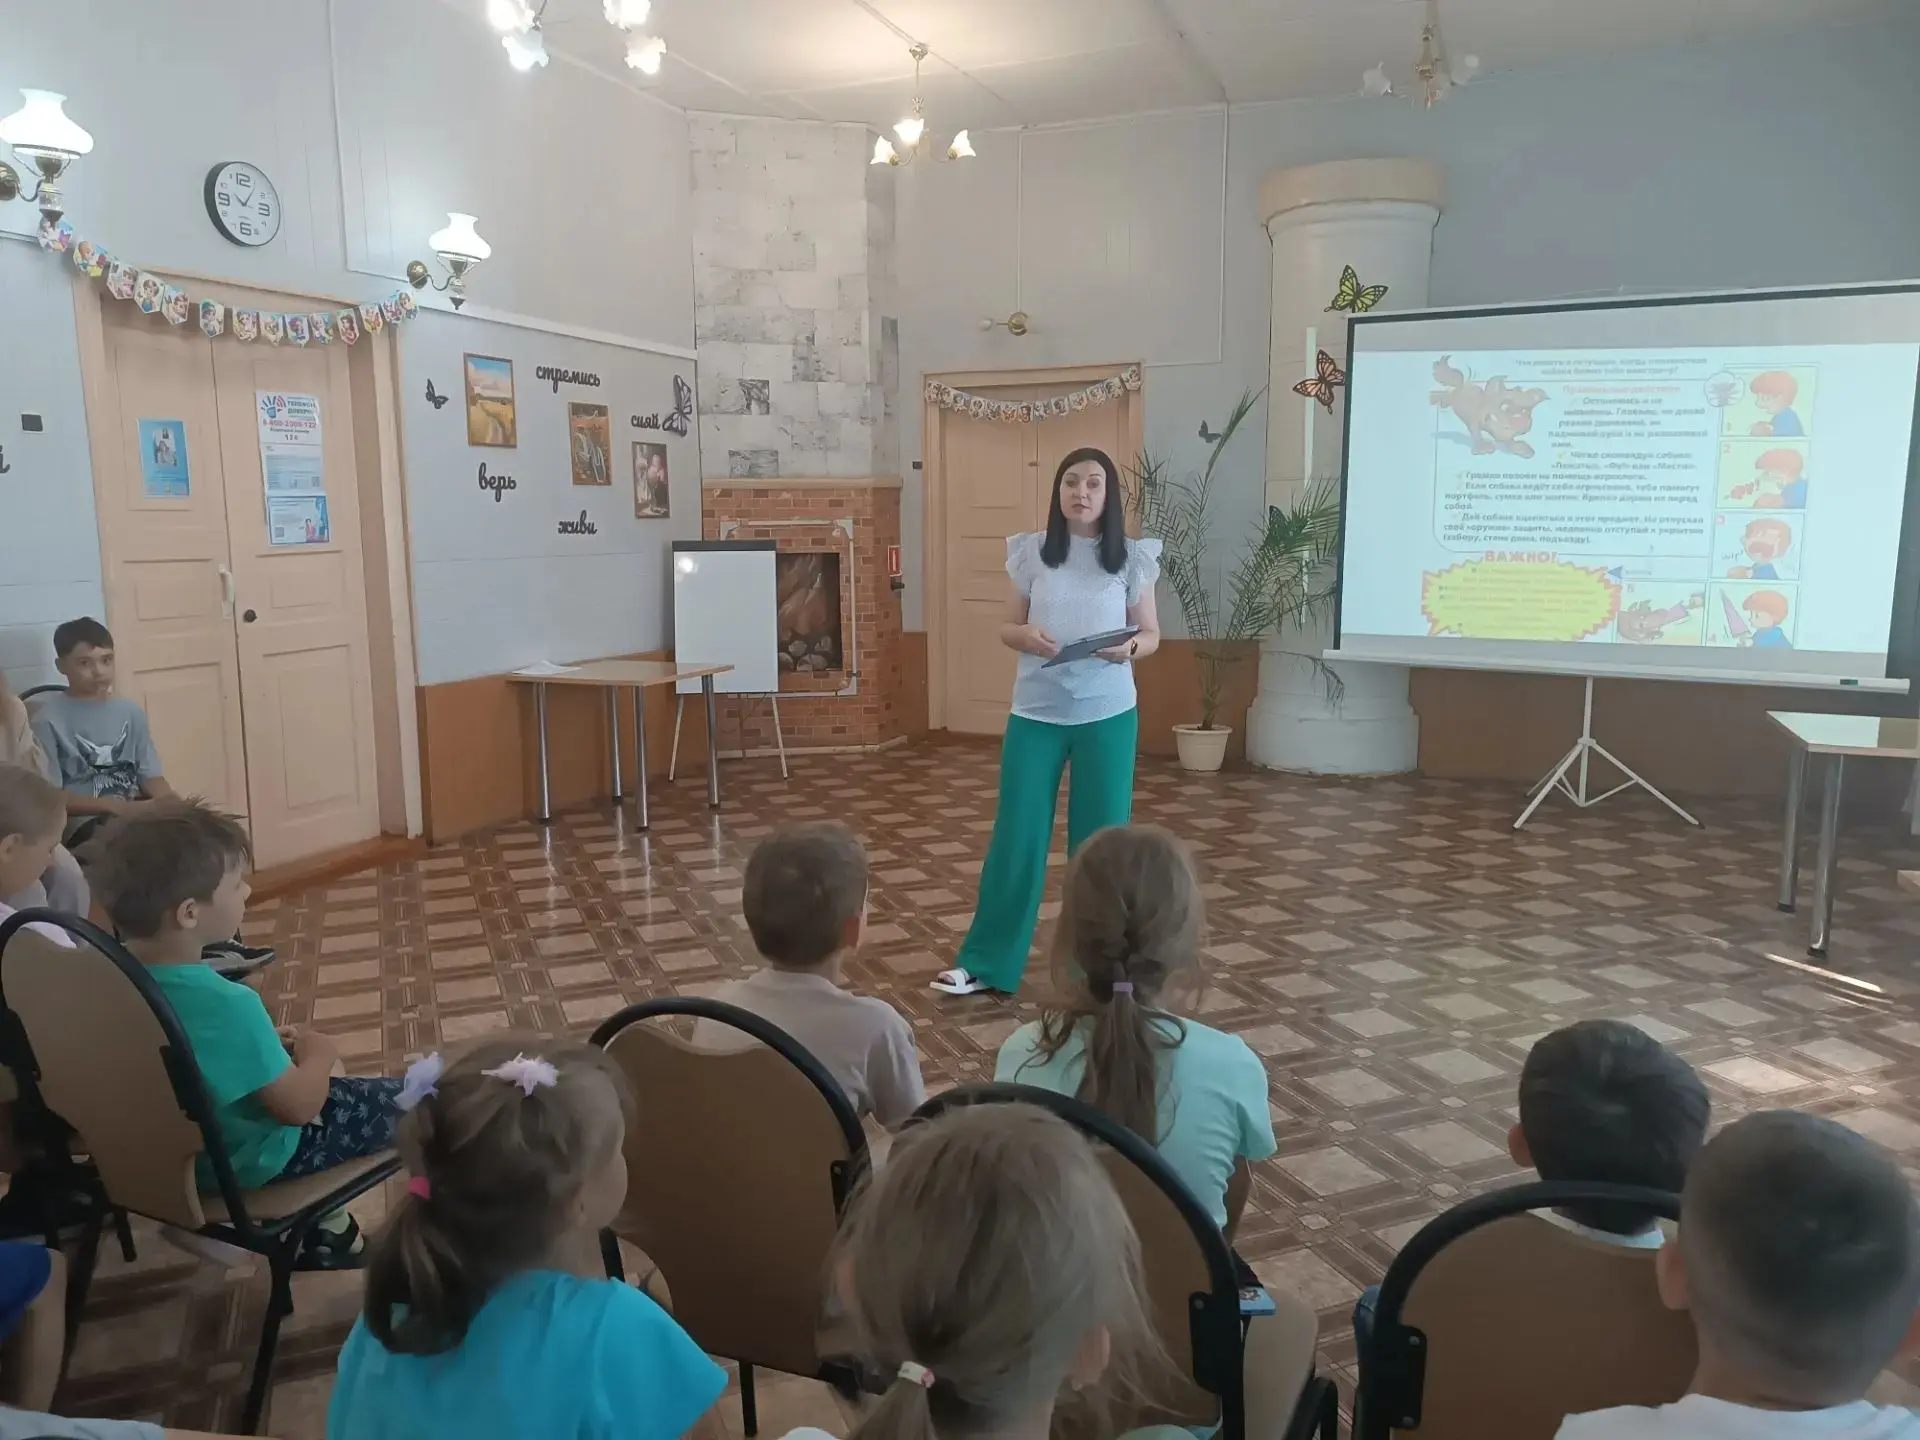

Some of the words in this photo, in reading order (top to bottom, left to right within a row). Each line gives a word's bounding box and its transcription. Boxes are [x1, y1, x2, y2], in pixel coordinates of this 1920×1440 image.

[236, 172, 251, 188] 12
[218, 192, 231, 206] 9
[258, 202, 271, 217] 3
[240, 222, 252, 236] 6
[536, 366, 600, 394] стремись
[631, 413, 660, 430] сияй
[478, 462, 517, 503] верь
[558, 510, 597, 535] живи
[1483, 549, 1559, 565] ВАЖНО!
